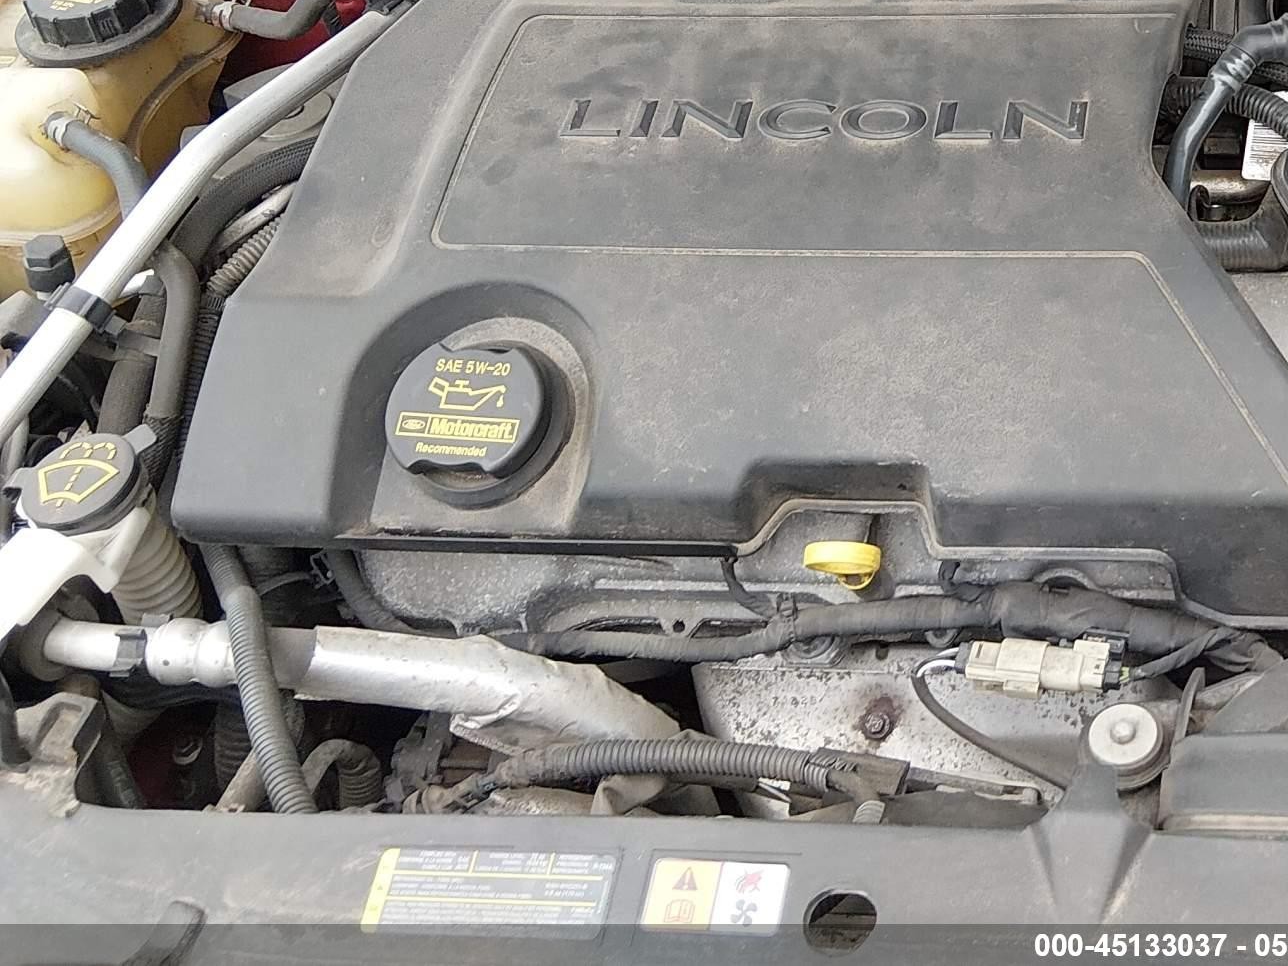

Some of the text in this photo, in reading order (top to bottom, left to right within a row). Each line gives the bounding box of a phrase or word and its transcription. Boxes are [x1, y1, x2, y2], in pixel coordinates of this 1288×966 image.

[560, 98, 1090, 141] LINCOLN
[435, 359, 511, 376] SAE 5W-20
[415, 442, 487, 457] Recommended
